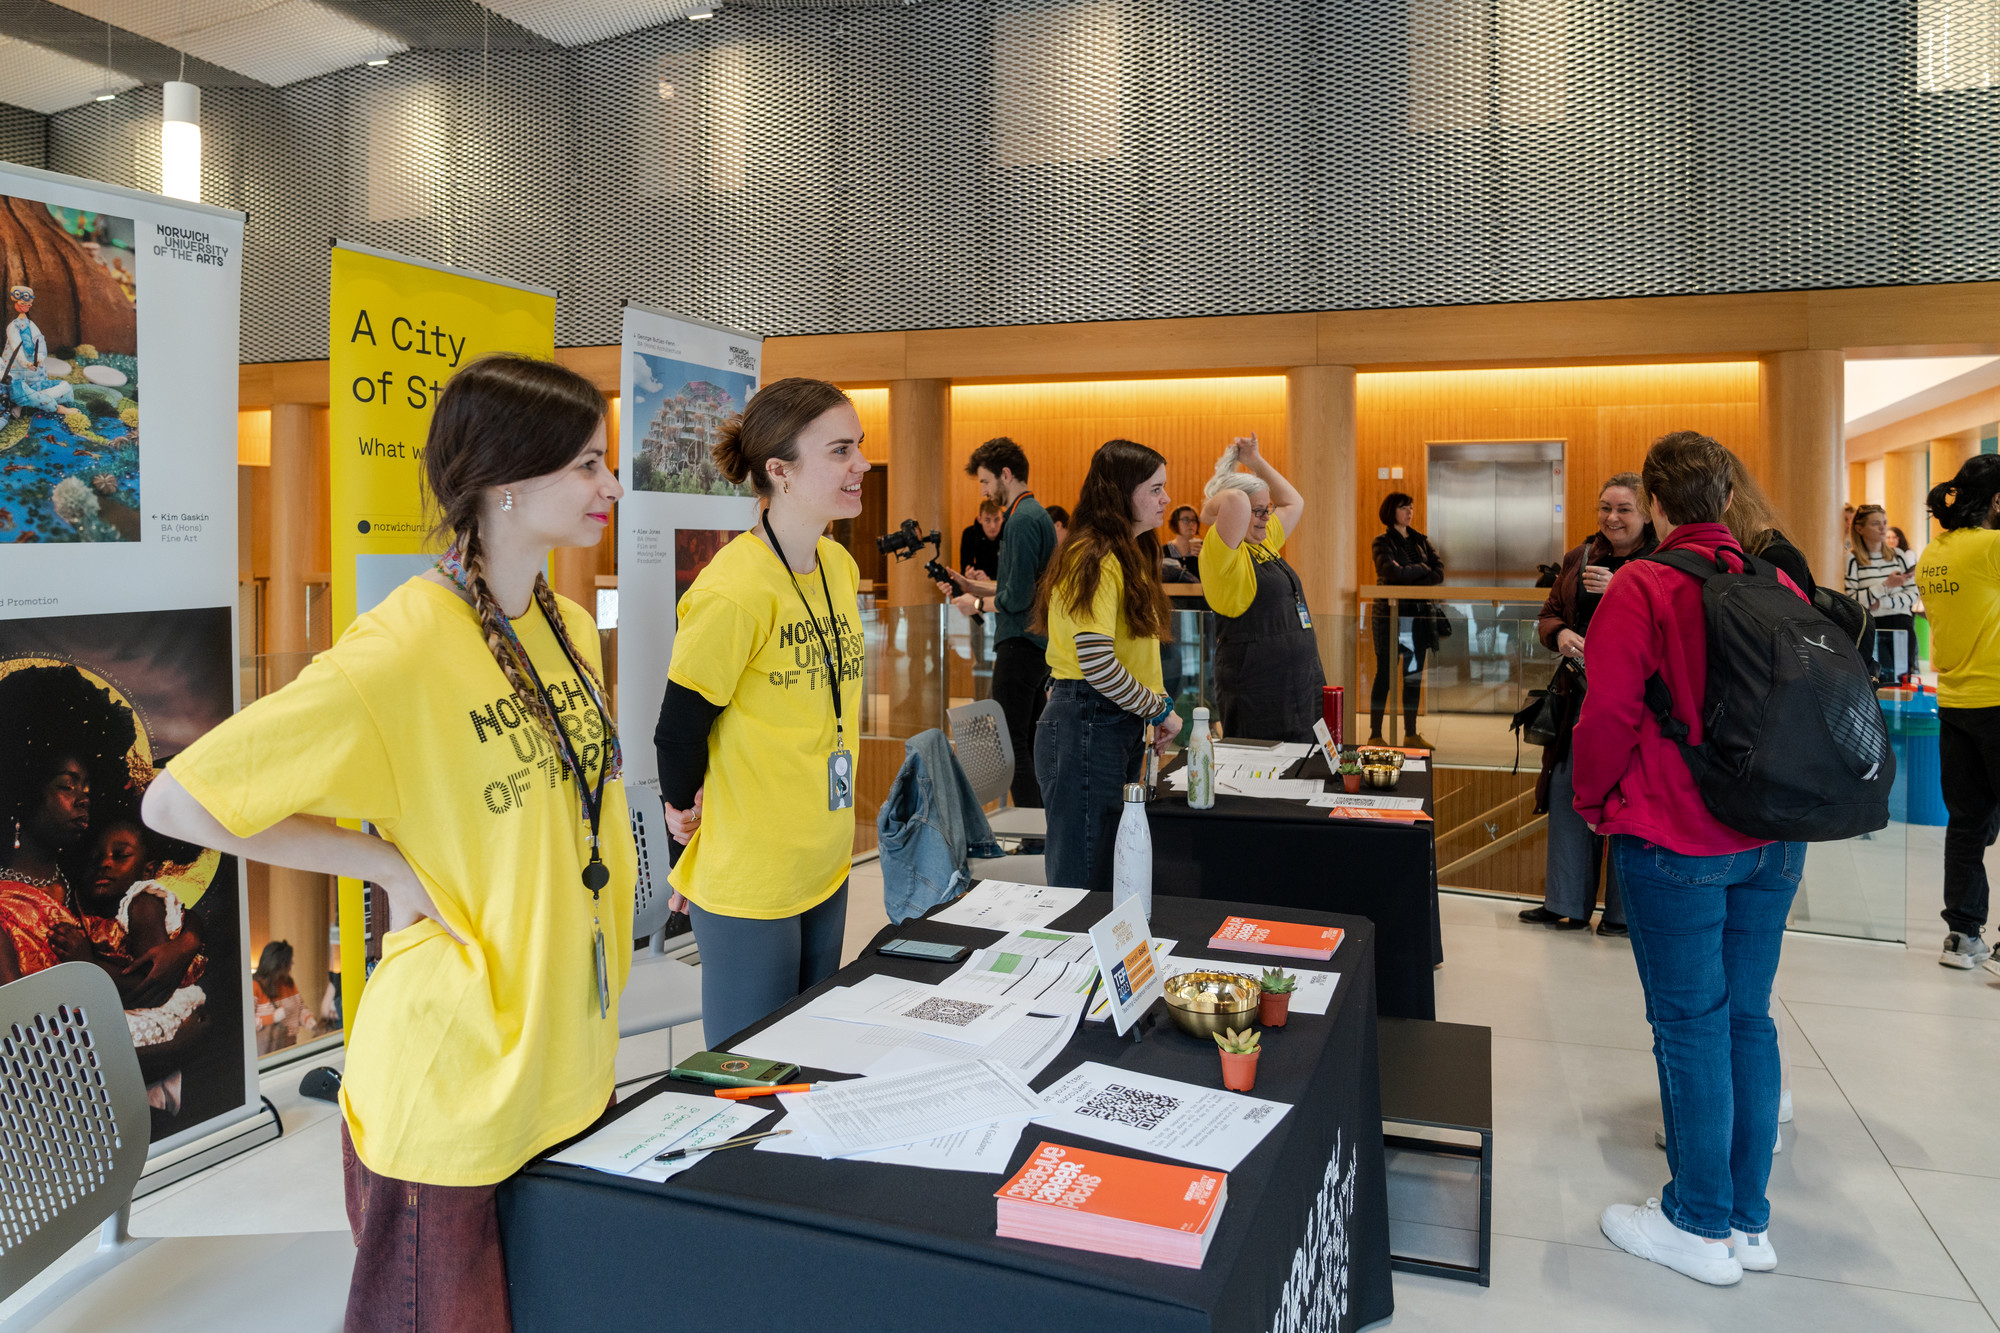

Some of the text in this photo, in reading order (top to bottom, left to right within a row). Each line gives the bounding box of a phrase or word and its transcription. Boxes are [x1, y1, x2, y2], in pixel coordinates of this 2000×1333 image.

[157, 224, 209, 243] NORWICH
[153, 245, 223, 266] OF THE ARTS
[165, 237, 228, 257] UNIVERSITY
[351, 309, 466, 367] A City
[729, 345, 749, 355] NORWICH
[353, 371, 393, 405] of
[359, 437, 405, 459] What
[161, 513, 209, 521] Kim Gaskin
[161, 524, 202, 533] BA (Hons)
[1921, 565, 1948, 579] Here
[1929, 579, 1960, 595] help
[7, 597, 59, 607] Promotion
[769, 670, 800, 690] OF
[484, 767, 531, 814] OF
[1114, 967, 1126, 987] TEF
[1118, 984, 1130, 999] 2023
